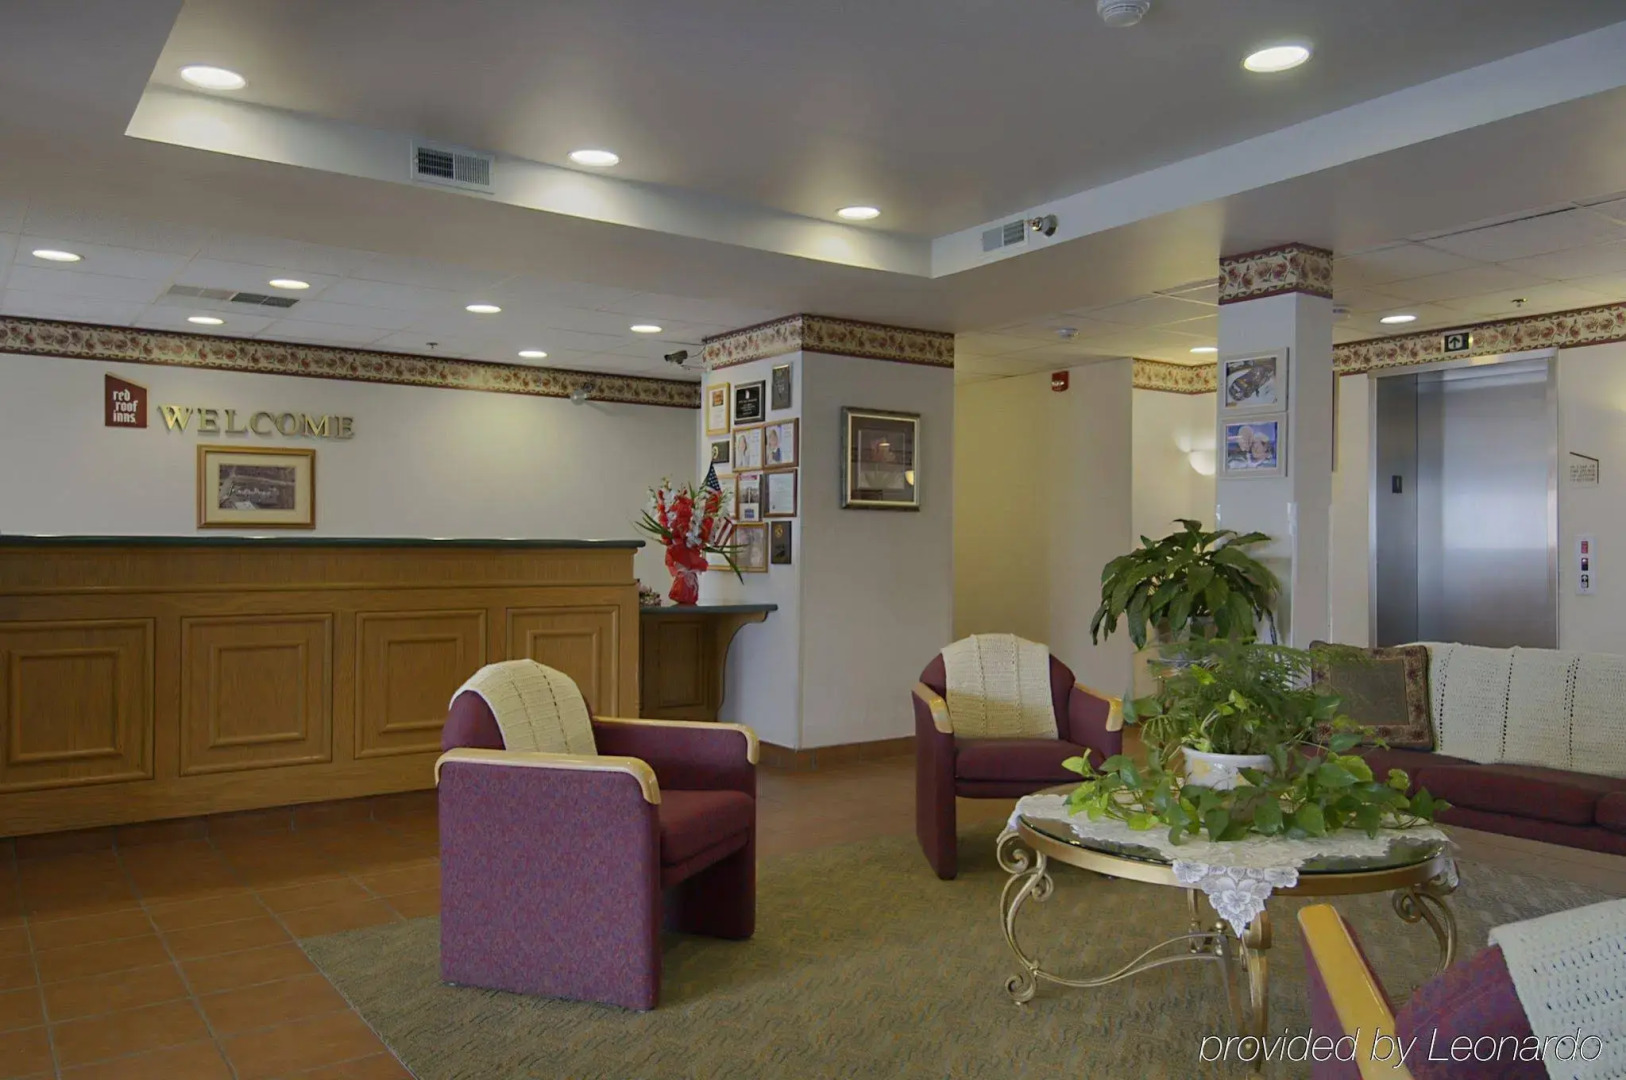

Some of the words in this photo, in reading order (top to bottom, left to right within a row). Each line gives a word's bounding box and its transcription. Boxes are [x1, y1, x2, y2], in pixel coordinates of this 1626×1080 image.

[113, 389, 131, 401] red
[115, 400, 138, 412] roof
[113, 410, 136, 423] inns
[158, 404, 354, 438] WELCOME
